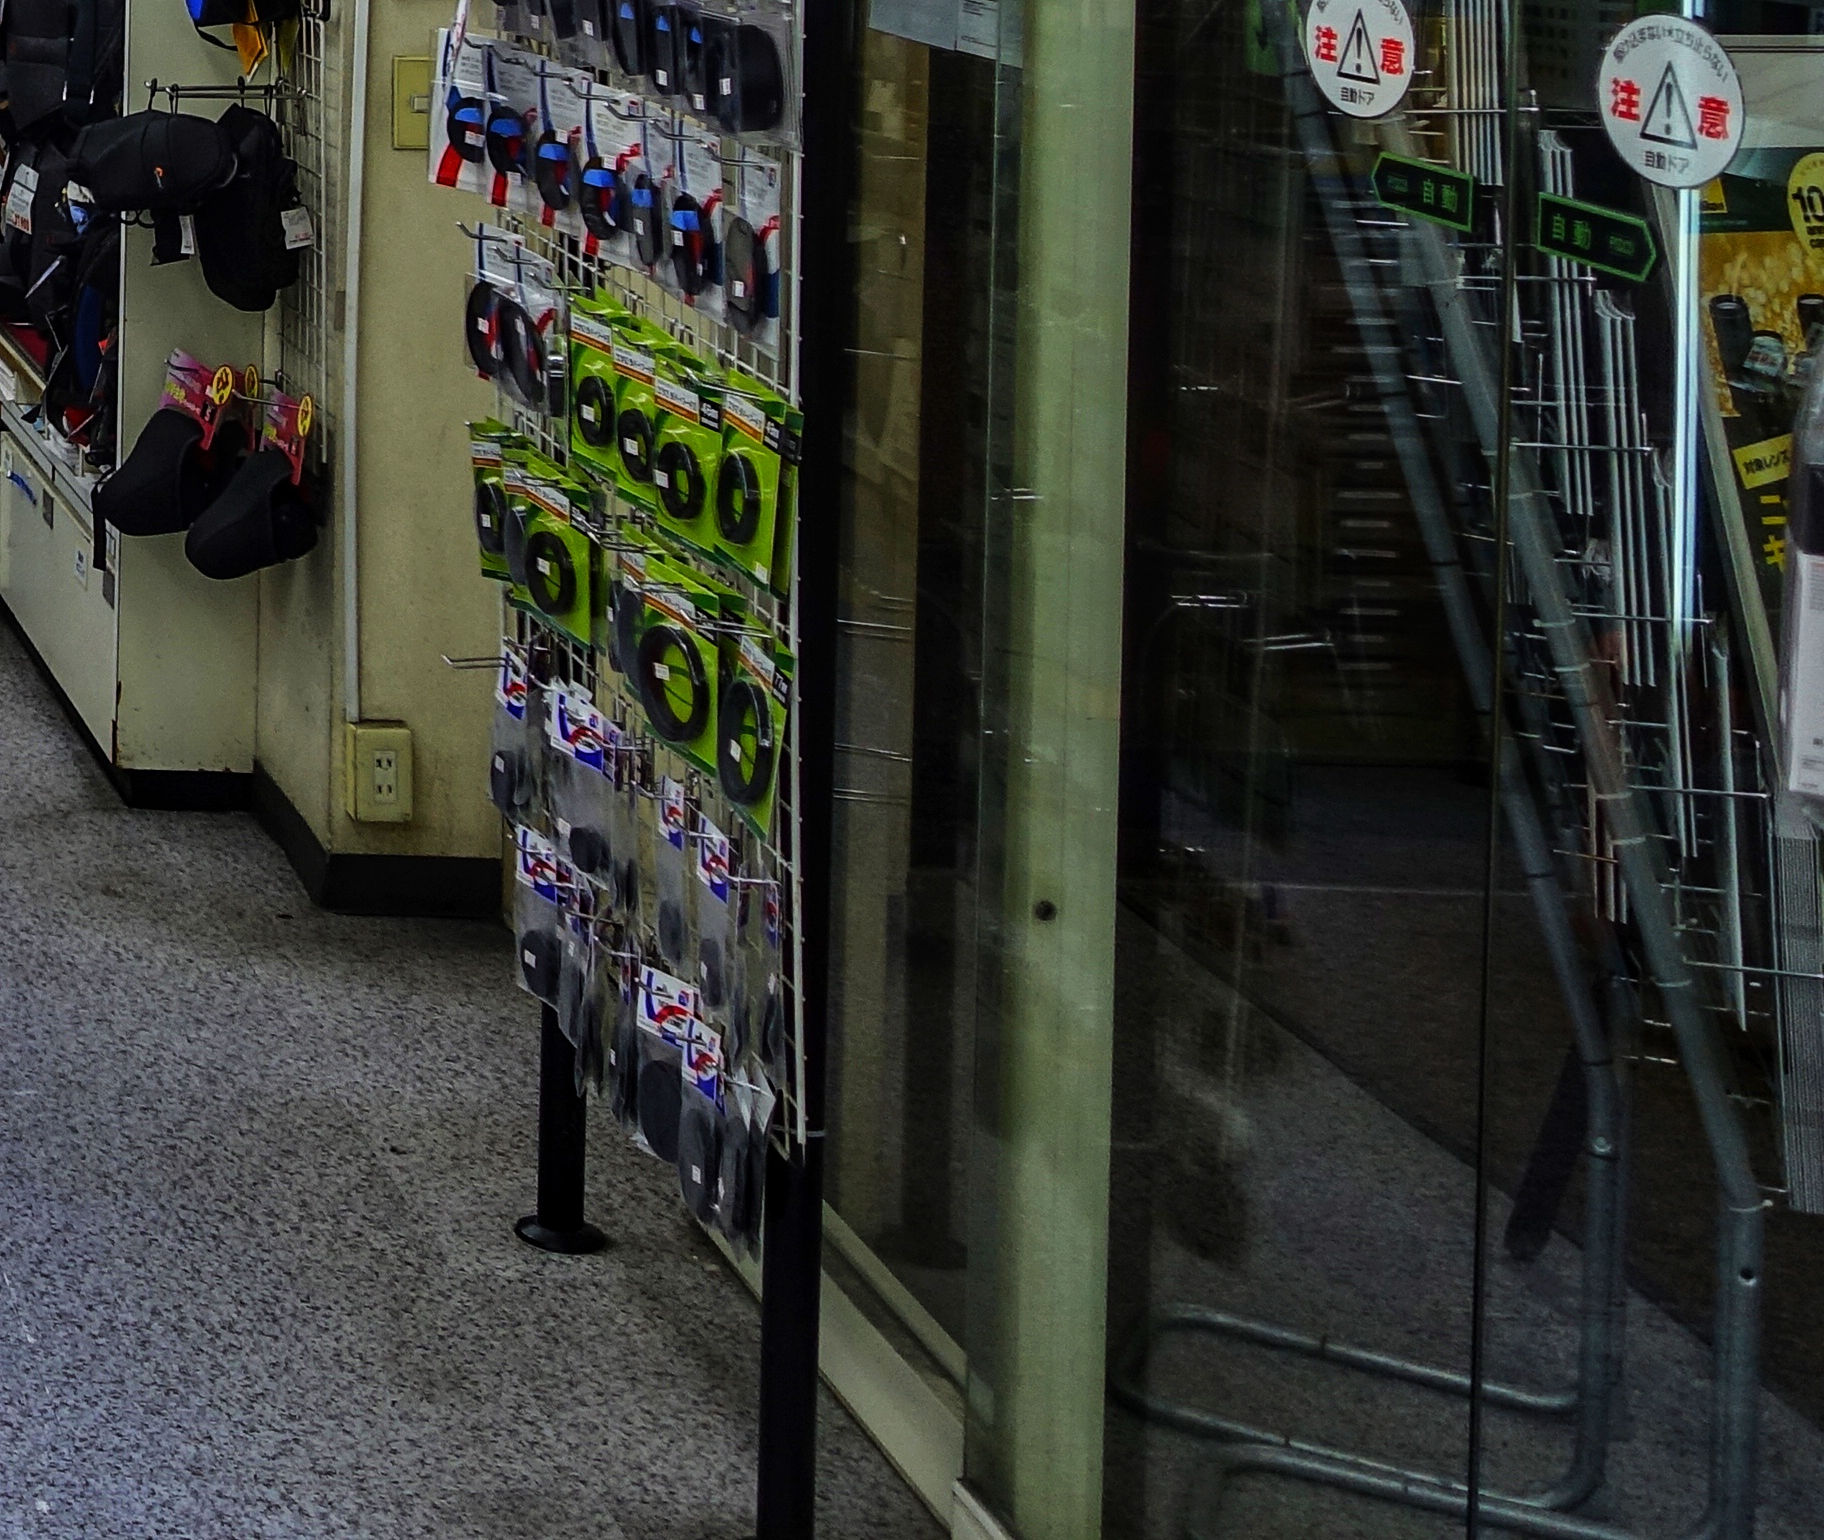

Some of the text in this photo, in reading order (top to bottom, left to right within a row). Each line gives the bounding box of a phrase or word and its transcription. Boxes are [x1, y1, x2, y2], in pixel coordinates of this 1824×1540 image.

[1314, 25, 1404, 76] 注 意
[1610, 76, 1730, 140] 注 意
